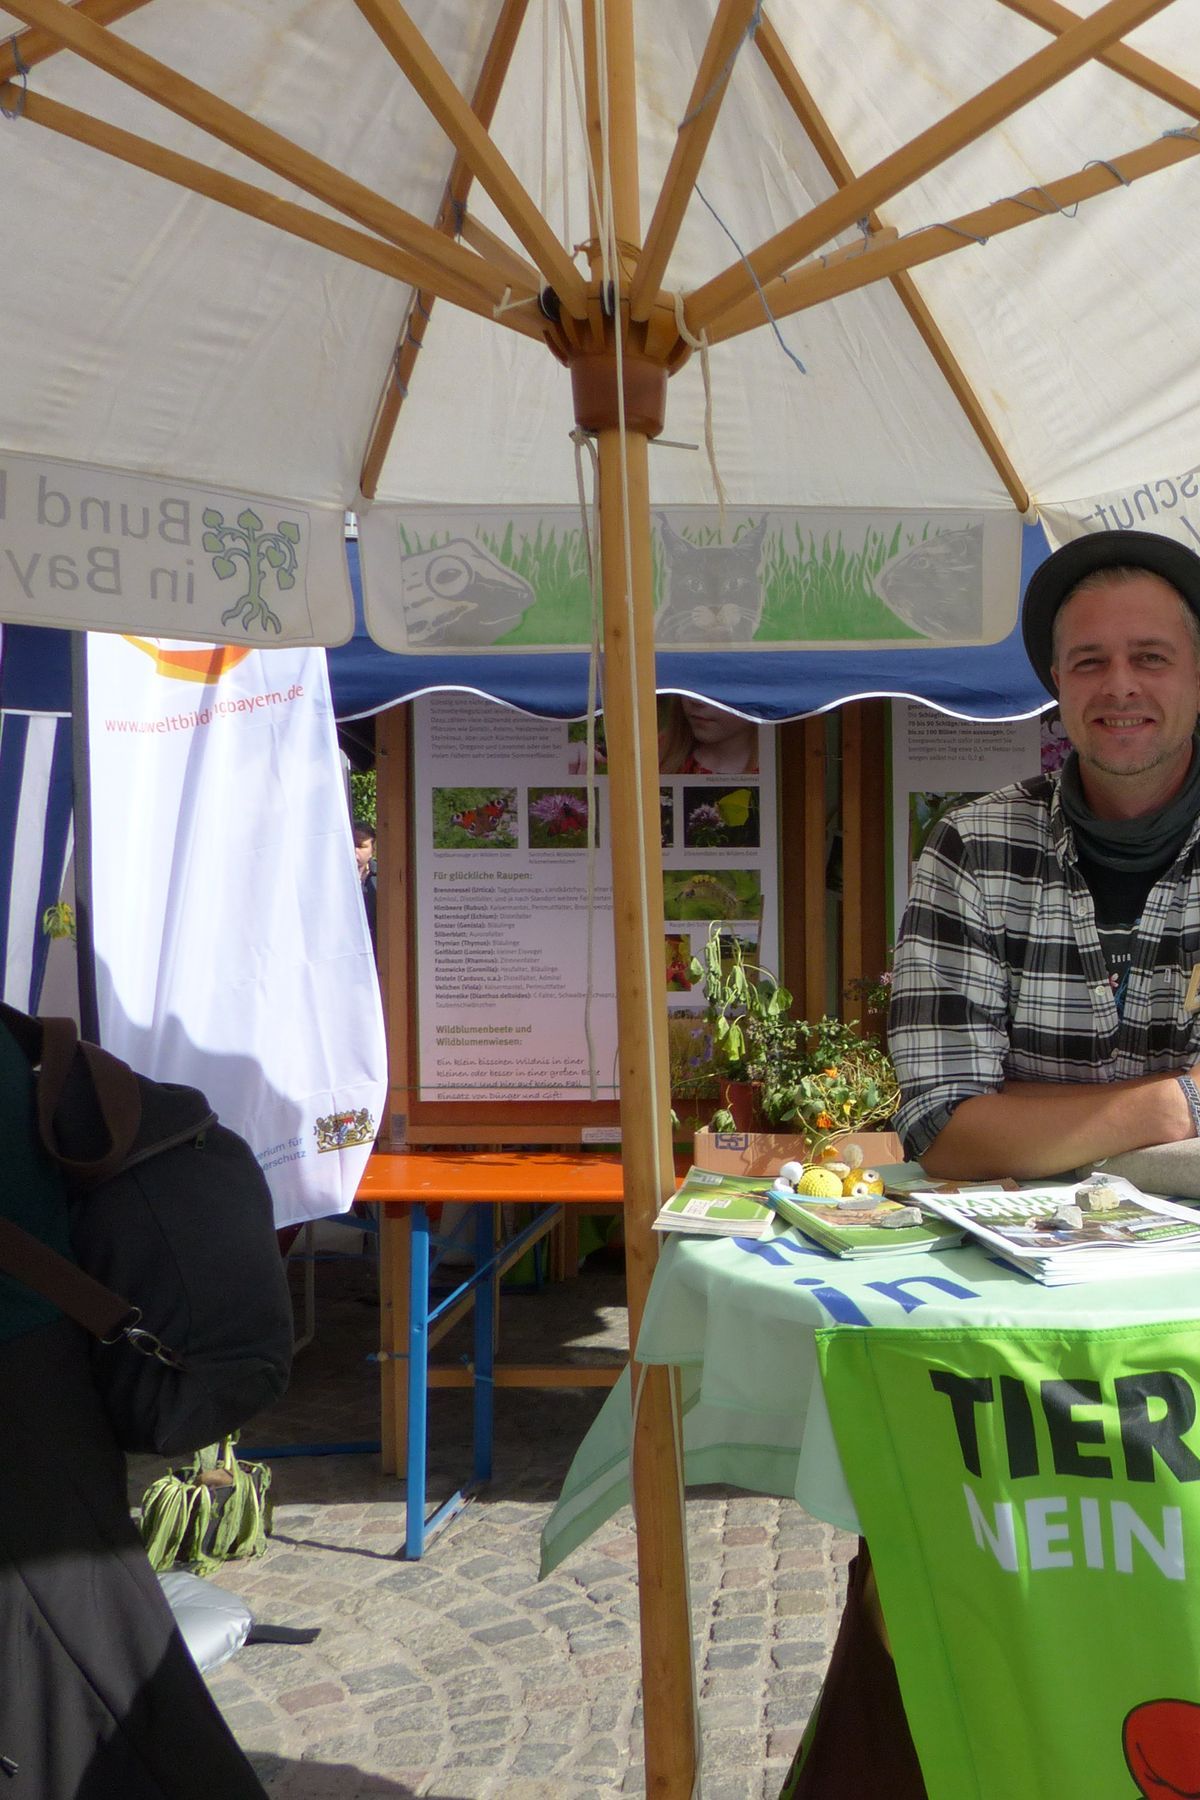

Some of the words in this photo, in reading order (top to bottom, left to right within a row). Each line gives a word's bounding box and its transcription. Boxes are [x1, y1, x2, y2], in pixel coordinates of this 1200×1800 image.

[433, 871, 447, 882] Für
[435, 1025, 514, 1034] Wildblumenbeete
[515, 1025, 532, 1034] und
[262, 1150, 307, 1171] erschutz
[962, 1481, 1187, 1581] NEIN
